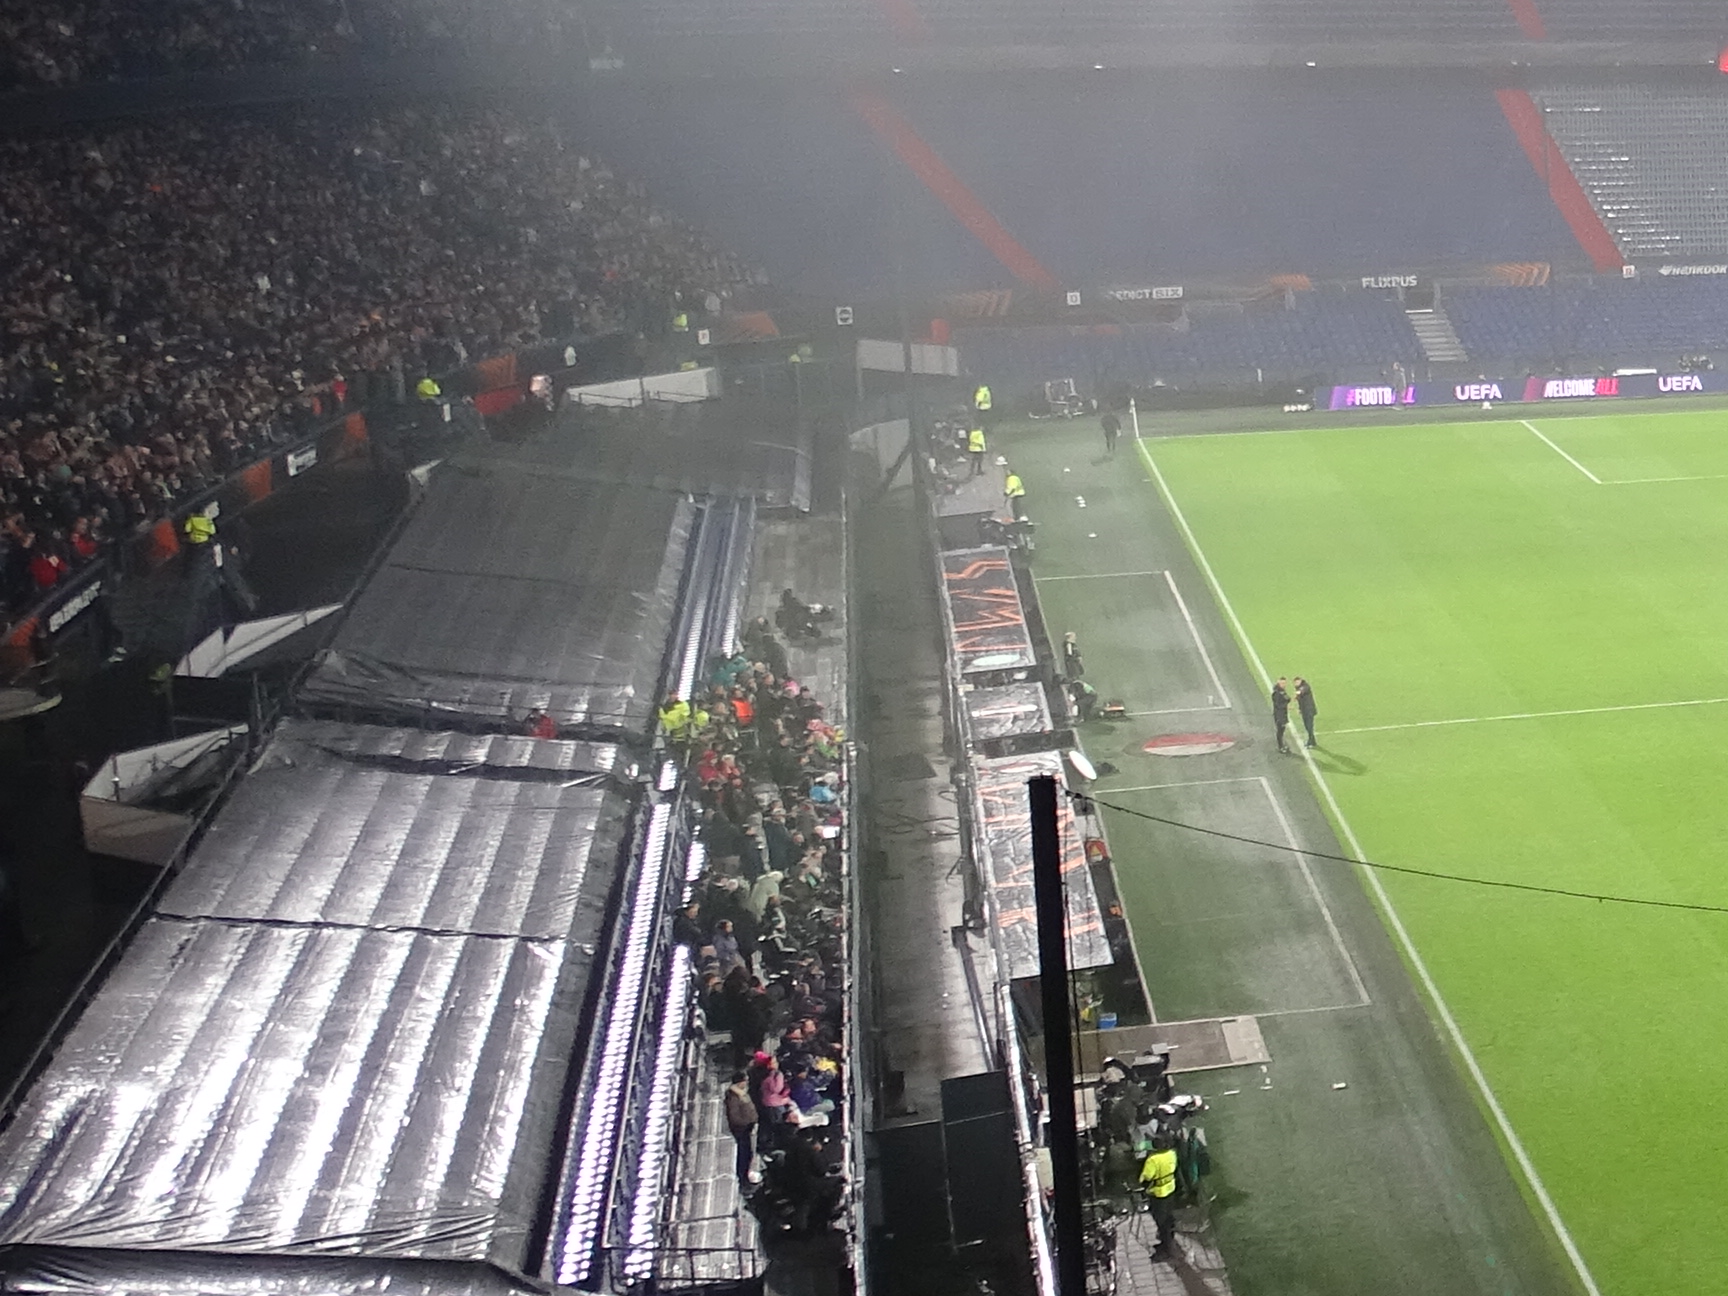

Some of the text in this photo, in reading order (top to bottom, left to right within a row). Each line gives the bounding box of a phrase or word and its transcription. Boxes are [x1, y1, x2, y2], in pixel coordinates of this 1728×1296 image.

[1454, 383, 1502, 401] UEFA
[1658, 375, 1703, 392] UEFA
[1346, 384, 1416, 406] #FOOTBL
